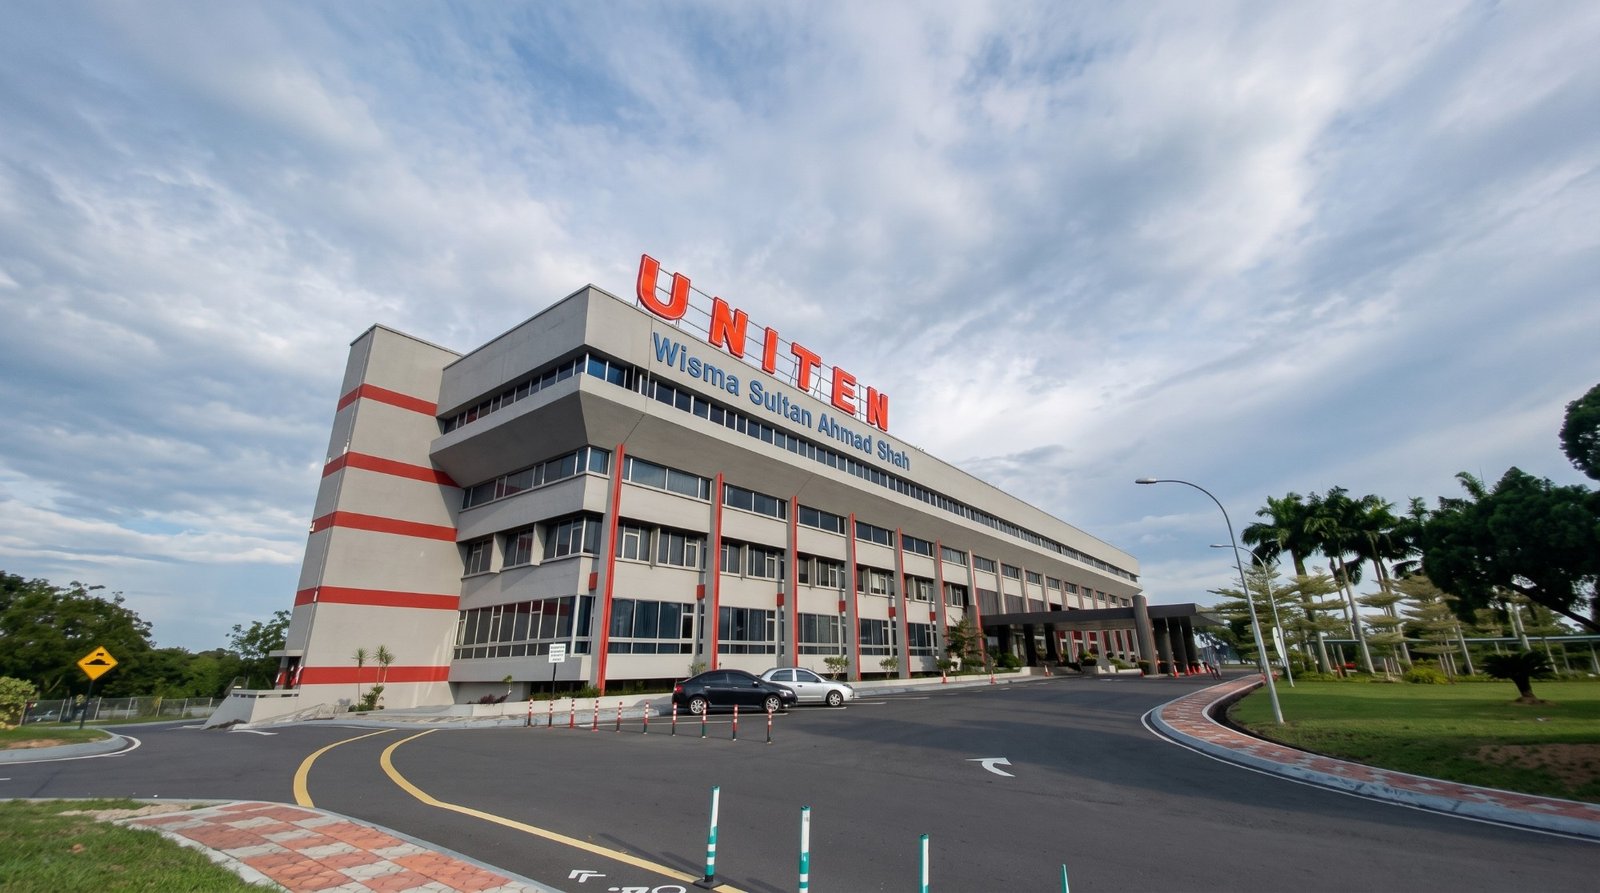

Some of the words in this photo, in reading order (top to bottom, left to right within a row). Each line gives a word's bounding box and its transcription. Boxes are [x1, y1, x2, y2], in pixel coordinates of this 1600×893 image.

[636, 253, 889, 432] UNITEN
[653, 331, 740, 397] Wisma
[749, 379, 812, 429] Sultan
[818, 413, 873, 454] Ahmad
[877, 439, 911, 472] Shah
